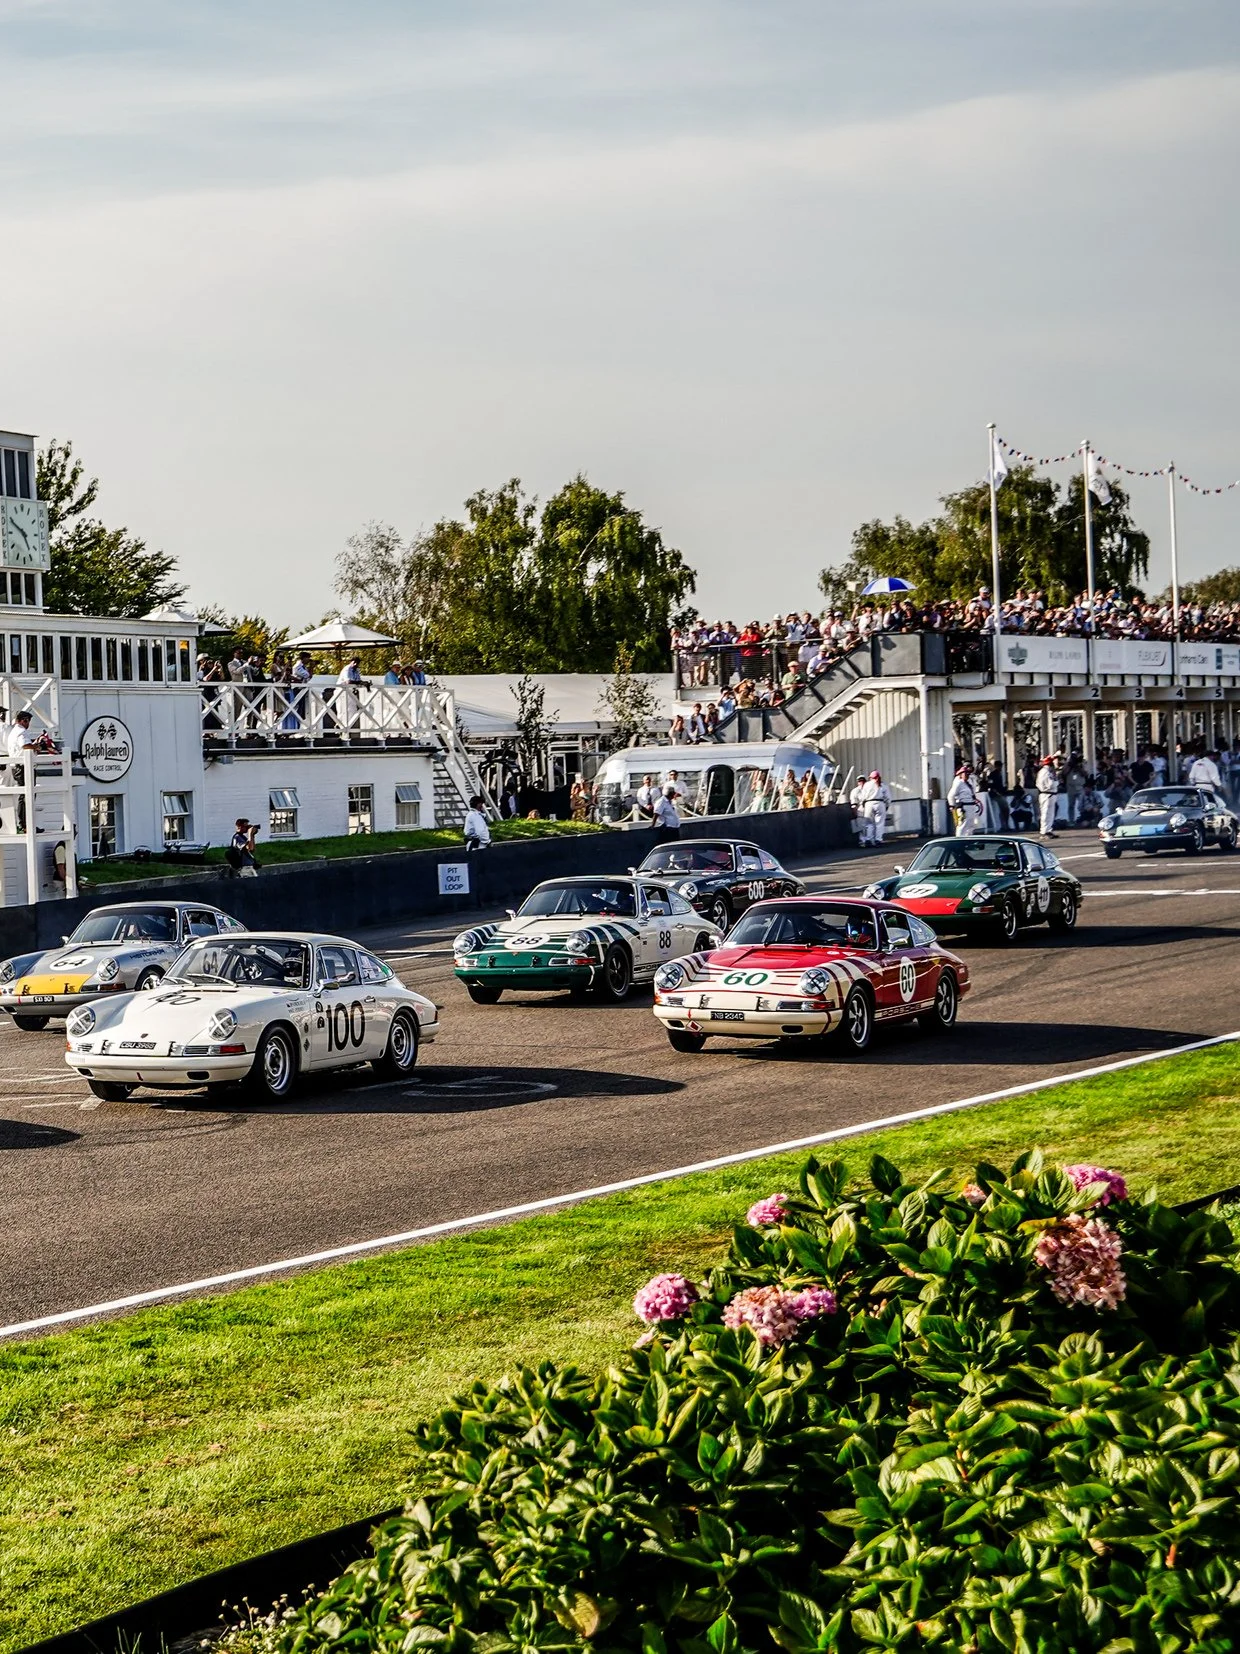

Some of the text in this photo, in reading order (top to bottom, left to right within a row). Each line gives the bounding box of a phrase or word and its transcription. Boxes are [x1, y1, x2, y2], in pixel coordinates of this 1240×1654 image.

[0, 505, 8, 560] ROLEX
[39, 509, 47, 562] ROLEX
[1091, 688, 1099, 697] 2
[1135, 688, 1142, 698] 3
[1176, 688, 1184, 697] 4
[1215, 688, 1222, 697] 5
[85, 741, 129, 762] Ralph Lauren
[444, 883, 464, 891] LOOP
[748, 881, 765, 900] 600
[511, 936, 543, 945] 88
[659, 930, 671, 949] 88
[53, 958, 87, 967] 64
[202, 951, 218, 974] 64
[723, 971, 769, 986] 60
[901, 964, 914, 994] 60
[882, 1003, 922, 1016] PORSCHE
[326, 1000, 365, 1052] 100
